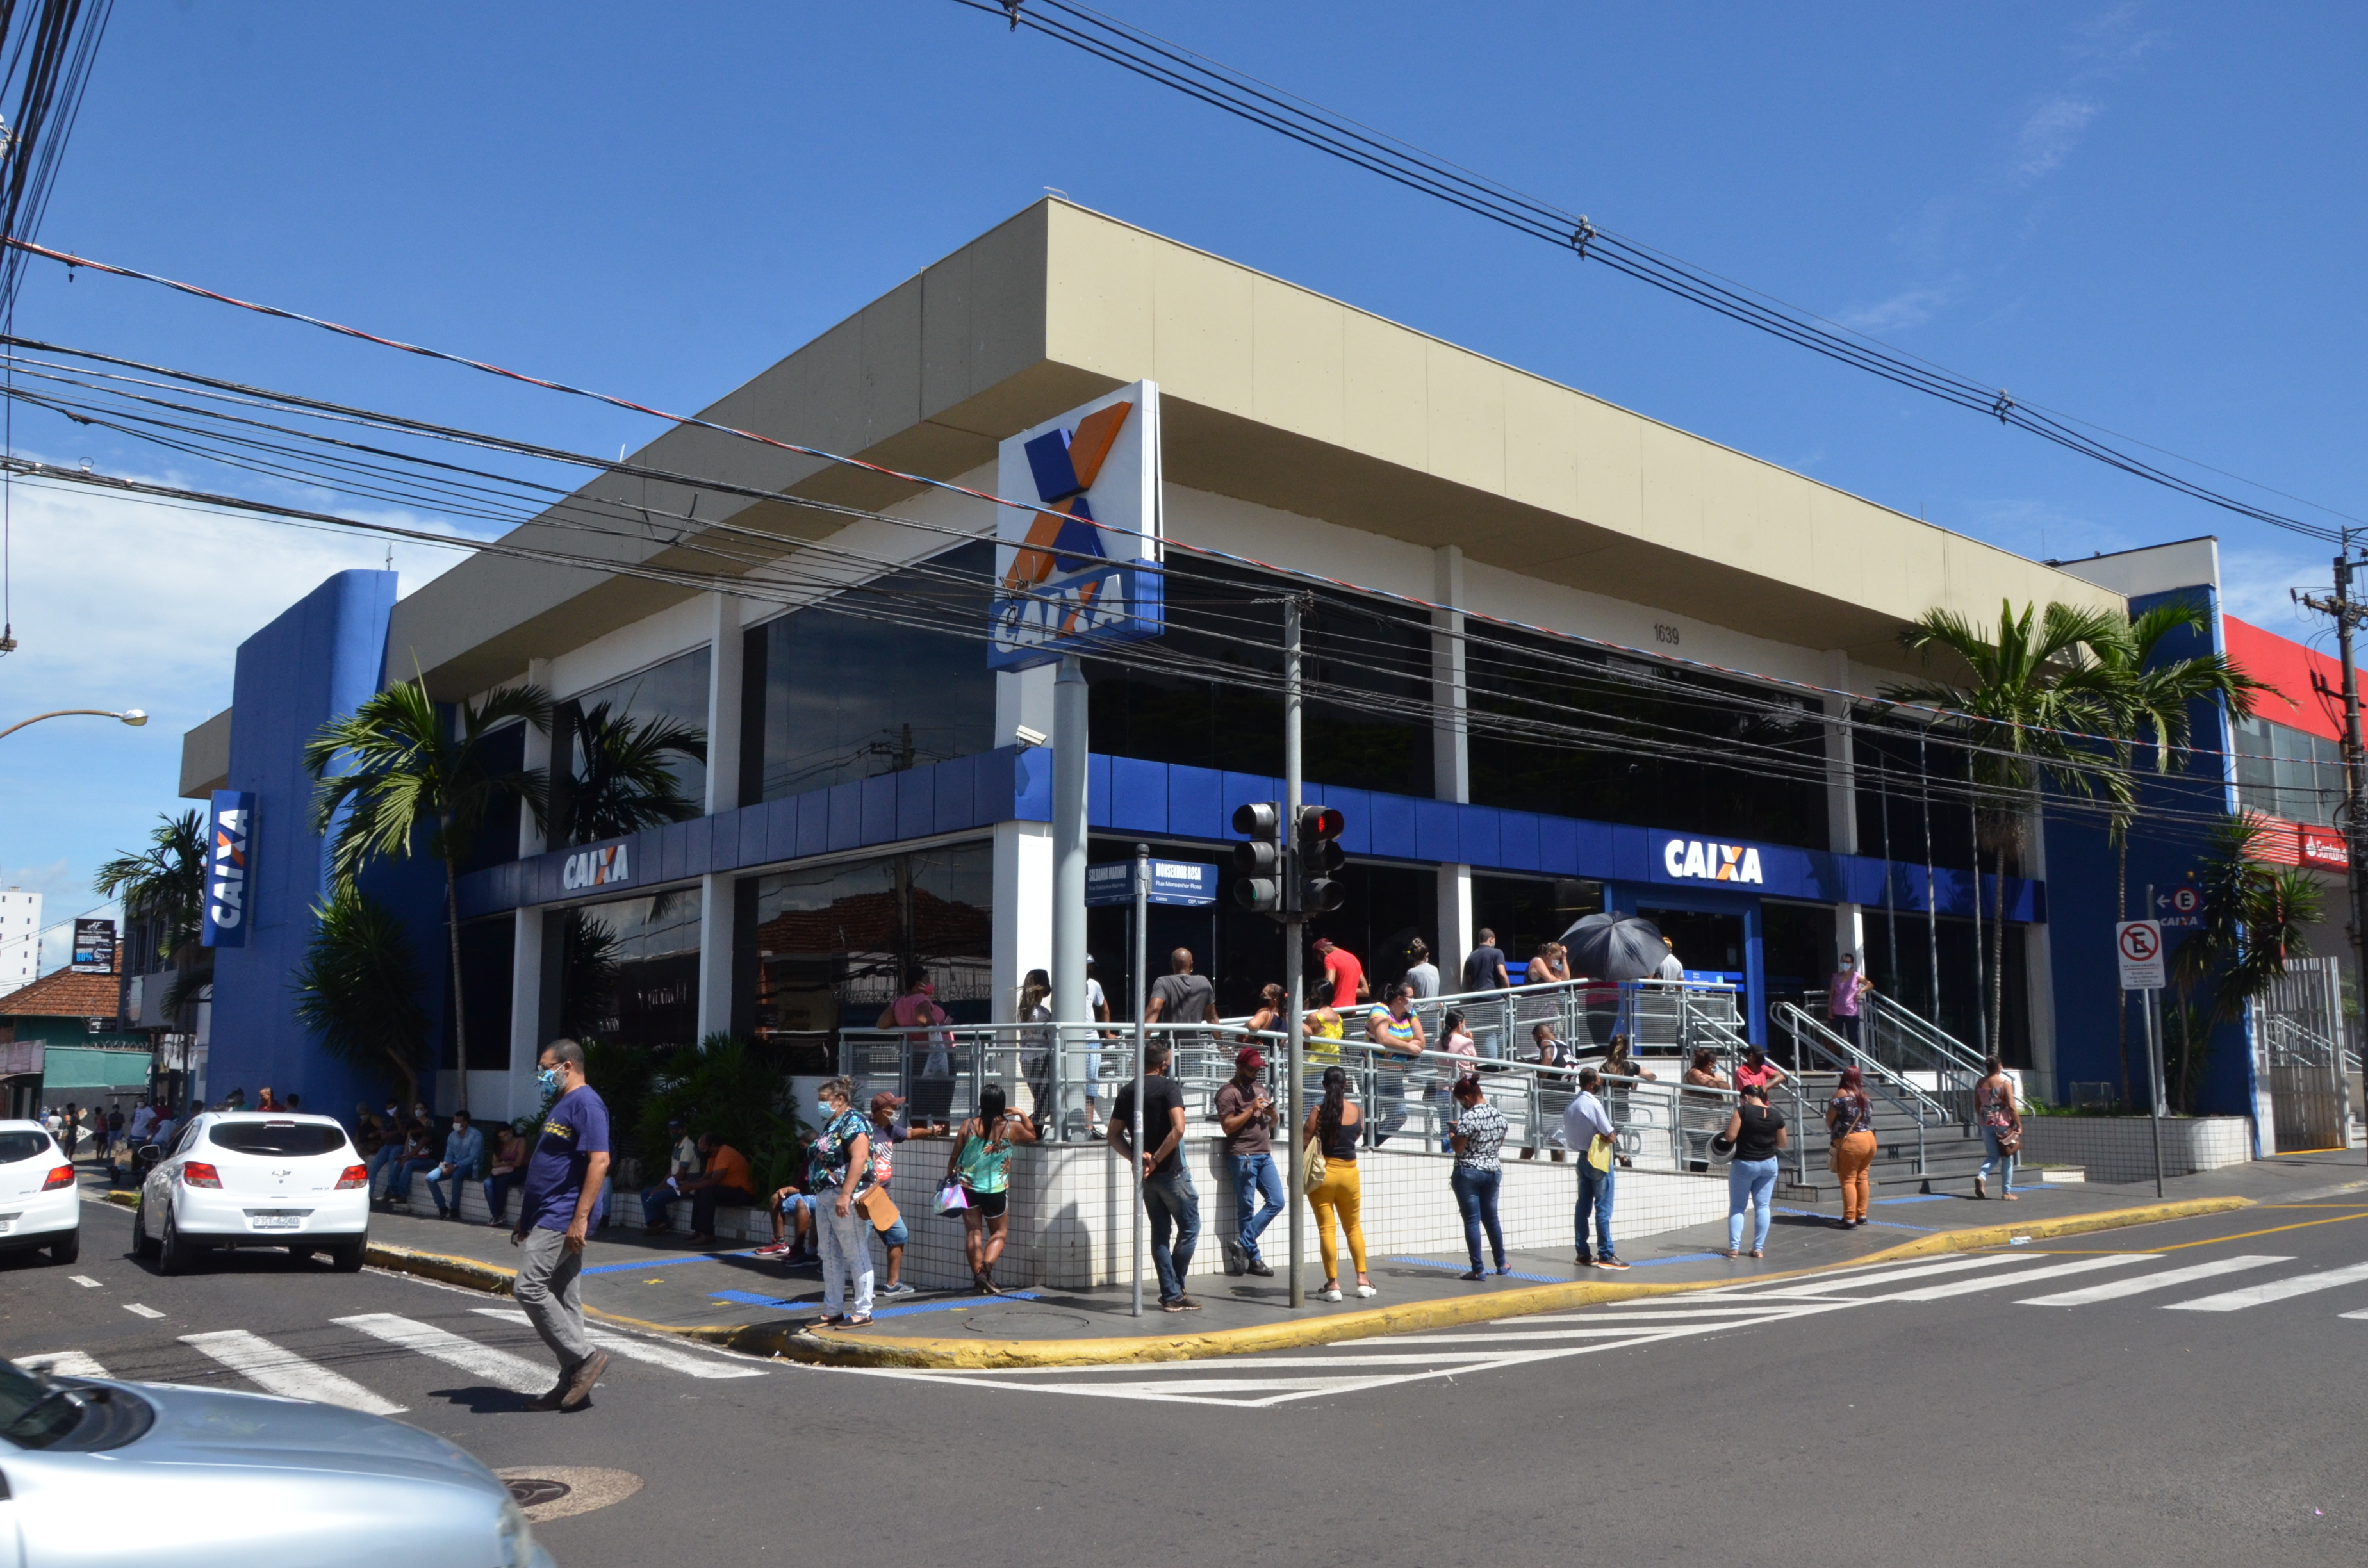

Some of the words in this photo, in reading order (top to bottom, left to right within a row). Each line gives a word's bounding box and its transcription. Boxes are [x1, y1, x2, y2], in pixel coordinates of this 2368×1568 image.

[994, 574, 1125, 653] CAIXA
[1654, 623, 1679, 645] 1639
[1665, 840, 1763, 884] CAIXA
[2316, 840, 2348, 863] Santan
[211, 809, 248, 929] CAIXA
[564, 844, 629, 890] CAIXA
[1156, 863, 1187, 879] MONSENHOR
[1187, 865, 1201, 881] ROSA
[2180, 892, 2191, 908] E
[2160, 916, 2198, 927] CAIXA
[2132, 931, 2148, 954] E
[76, 952, 93, 962] 80%
